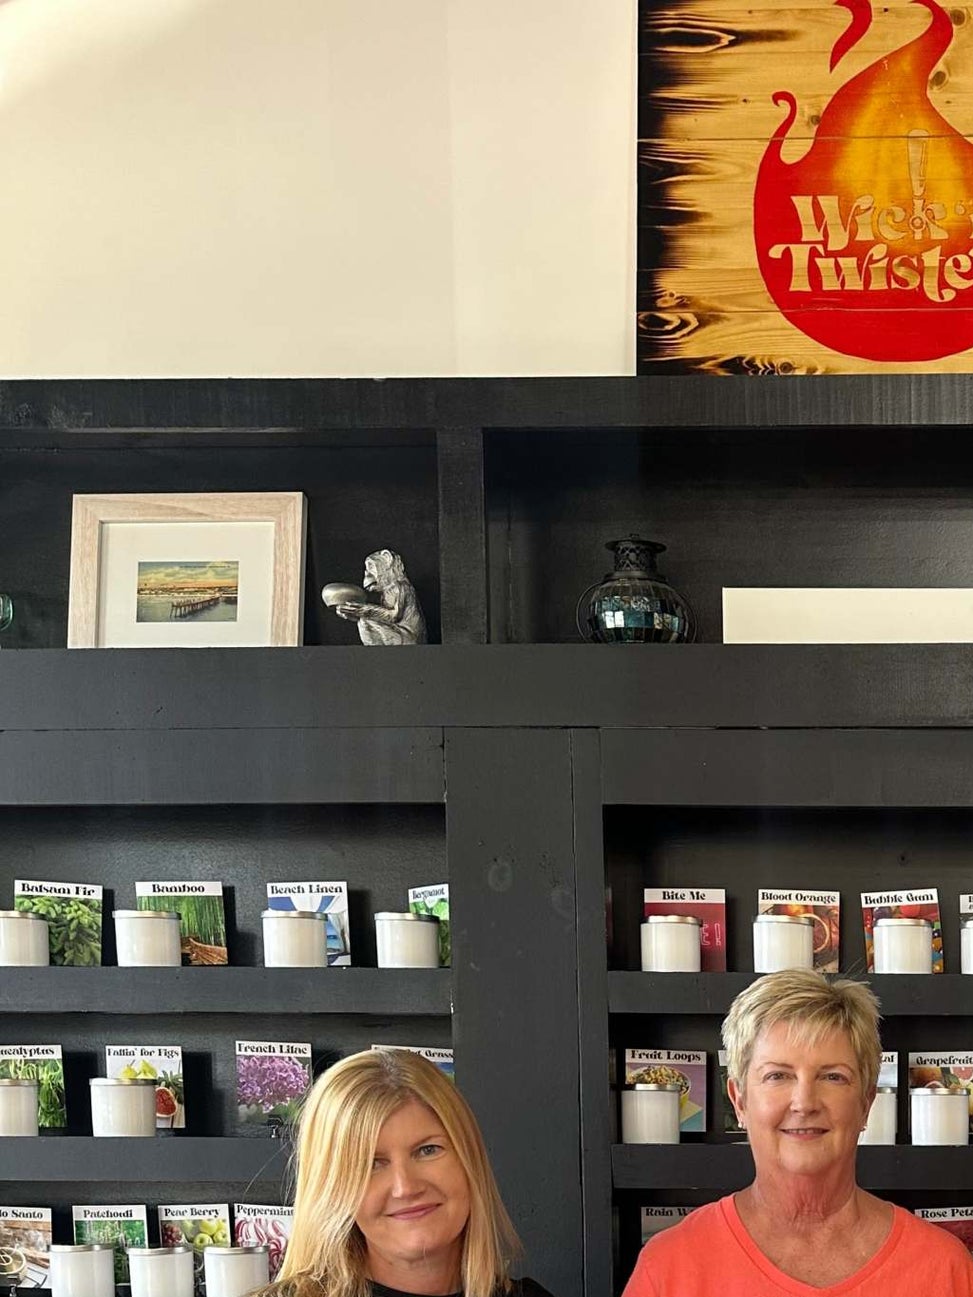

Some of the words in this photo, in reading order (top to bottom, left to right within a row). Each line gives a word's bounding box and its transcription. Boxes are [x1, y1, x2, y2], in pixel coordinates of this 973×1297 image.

[21, 882, 71, 895] Balsam
[75, 885, 95, 897] Fir
[152, 883, 205, 893] Bamboo
[271, 885, 305, 895] Beach
[308, 884, 343, 894] Linen
[662, 891, 686, 901] Bite
[689, 891, 706, 901] Me
[761, 891, 793, 901] Blood
[795, 893, 836, 904] Orange
[864, 895, 903, 905] Bubble
[906, 893, 934, 903] Gum
[0, 1047, 55, 1059] ucalyptus
[139, 1047, 155, 1057] for
[157, 1047, 179, 1059] Figs
[237, 1043, 275, 1054] French
[279, 1044, 308, 1055] Lilac
[631, 1050, 663, 1060] Fruit
[666, 1051, 701, 1062] Loops
[916, 1056, 973, 1066] Grapefruit
[11, 1210, 43, 1219] Santo
[83, 1208, 133, 1219] Patchouli
[164, 1208, 189, 1217] Pear
[190, 1207, 221, 1218] Berry
[645, 1208, 673, 1217] Rain
[921, 1210, 948, 1218] Rose
